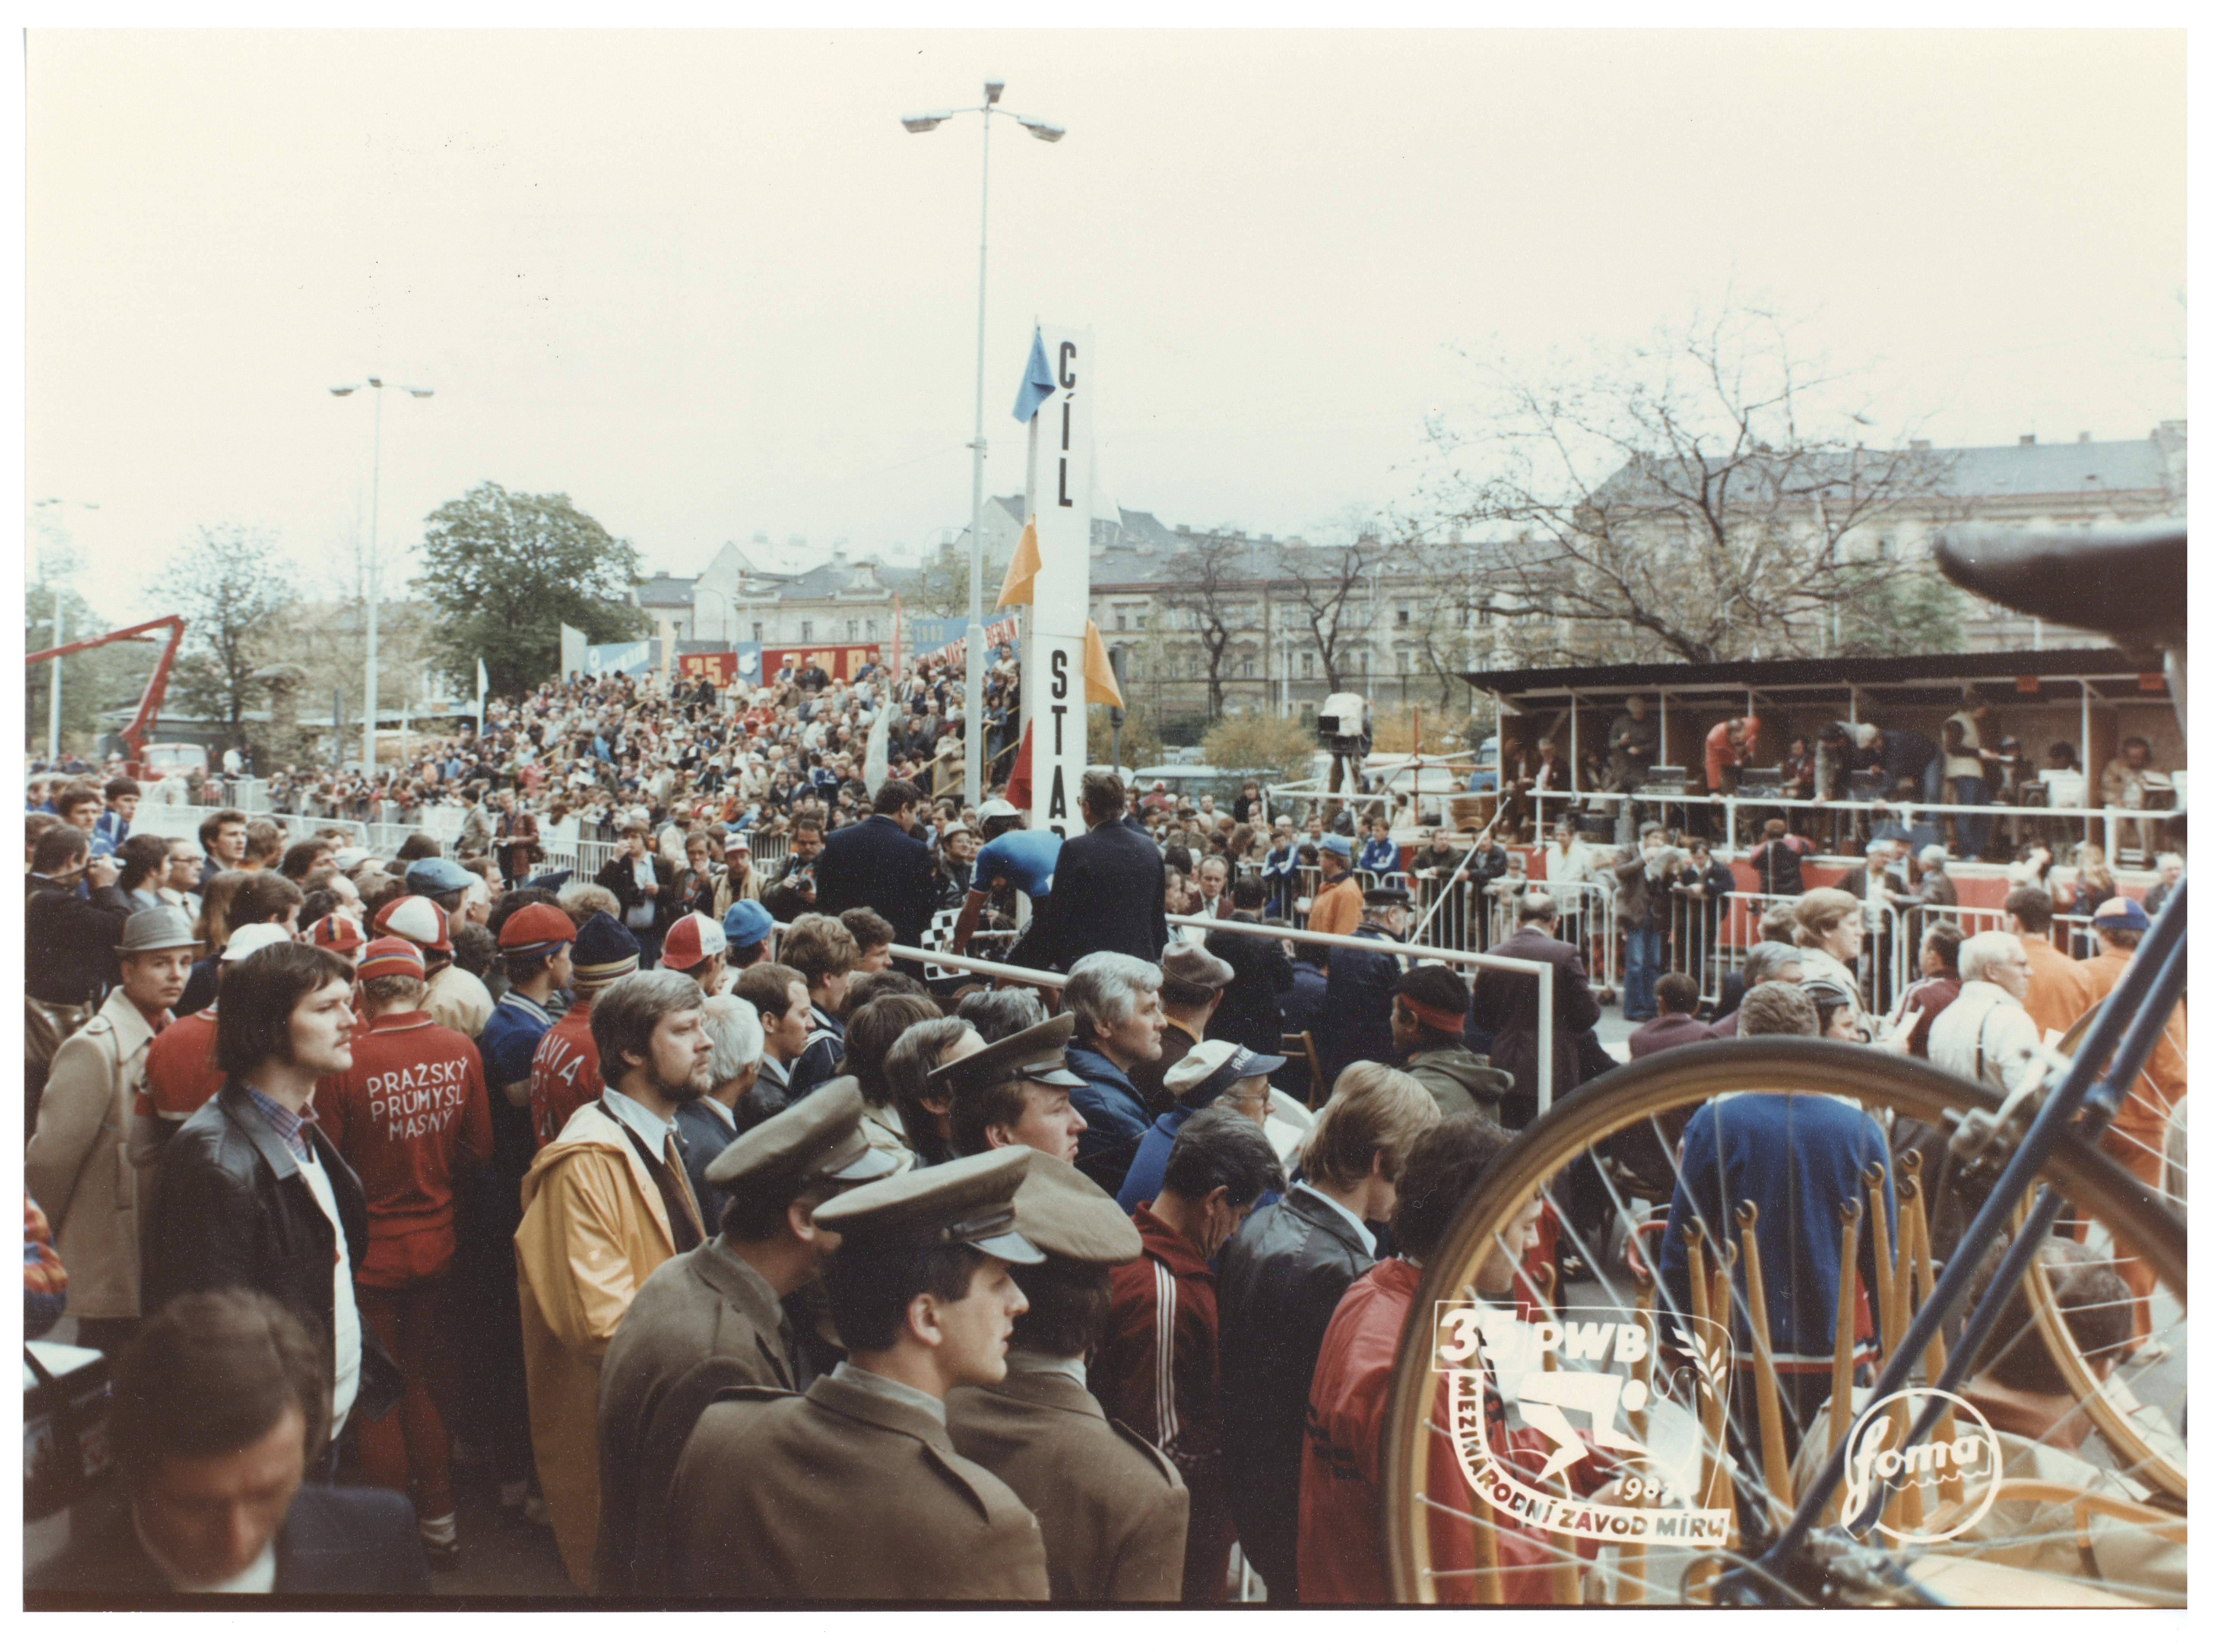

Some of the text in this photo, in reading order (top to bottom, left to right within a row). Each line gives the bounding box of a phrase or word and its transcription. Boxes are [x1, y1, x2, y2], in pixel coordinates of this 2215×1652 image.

[1059, 341, 1076, 507] CÍL
[984, 617, 1017, 650] BERLIN
[1049, 649, 1067, 840] STA
[532, 1033, 585, 1087] AVIA
